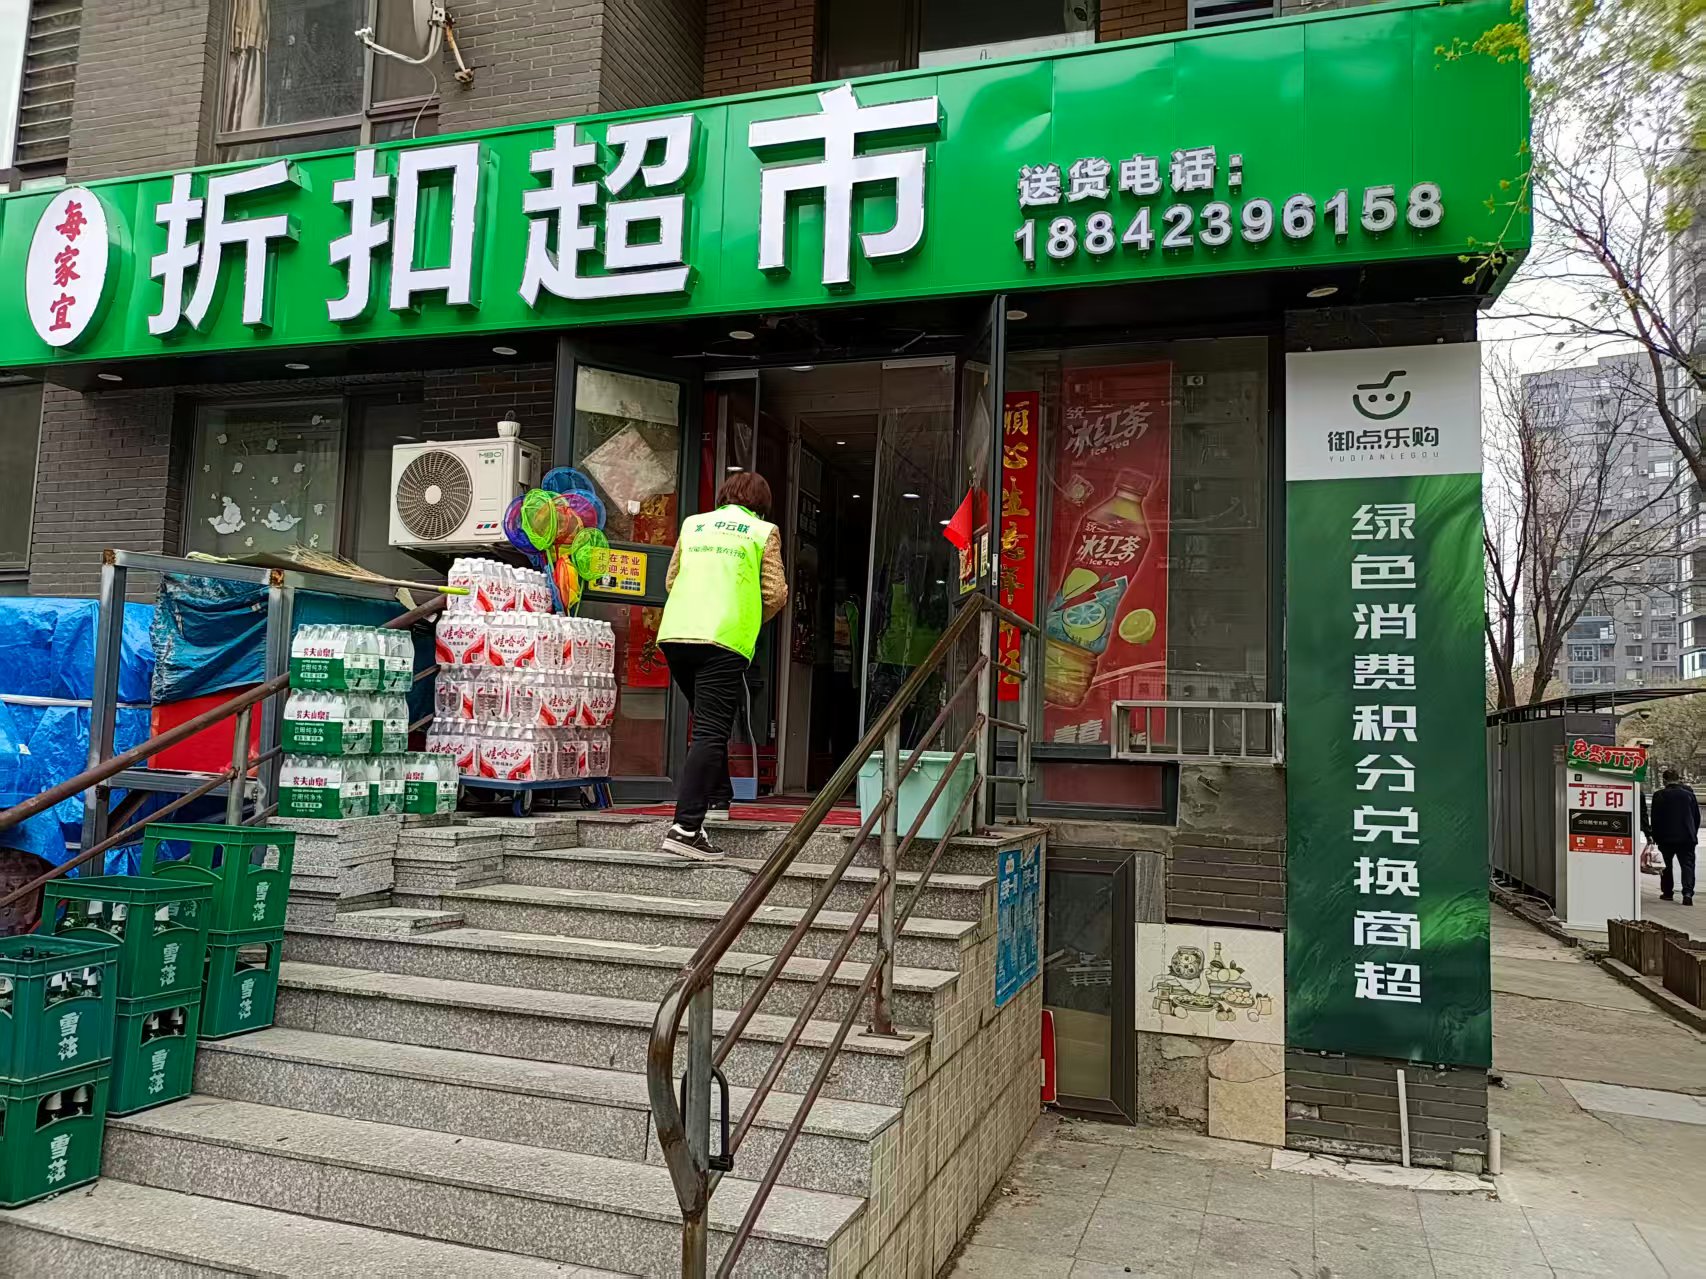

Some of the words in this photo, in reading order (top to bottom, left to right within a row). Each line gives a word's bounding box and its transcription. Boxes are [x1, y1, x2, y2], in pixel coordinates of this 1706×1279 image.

[147, 82, 939, 337] 折扣超市
[1013, 181, 1445, 264] 18842396158
[48, 200, 89, 333] 每家宜
[1064, 401, 1153, 458] 冰红茶
[1327, 426, 1440, 452] 御点乐购
[1329, 452, 1440, 462] YUDIANLEGOU
[714, 520, 751, 534] 中云联
[598, 552, 641, 566] 正在营业
[1076, 534, 1142, 563] 冰红茶
[1089, 558, 1103, 566] Ice
[1105, 558, 1120, 567] Tea
[597, 564, 640, 577] 欢迎光临
[442, 625, 478, 640] 娃哈哈
[493, 634, 528, 648] 娃哈哈
[485, 746, 523, 760] 娃哈哈
[1351, 502, 1422, 1003] 绿色消费积分兑换商超
[1578, 789, 1624, 809] 打印
[252, 880, 272, 922] 雪花
[159, 942, 181, 987] 雪花
[238, 977, 256, 1020] 雪花
[57, 1011, 82, 1062] 雪花
[147, 1048, 170, 1095] 雪花
[47, 1133, 72, 1184] 雪花
